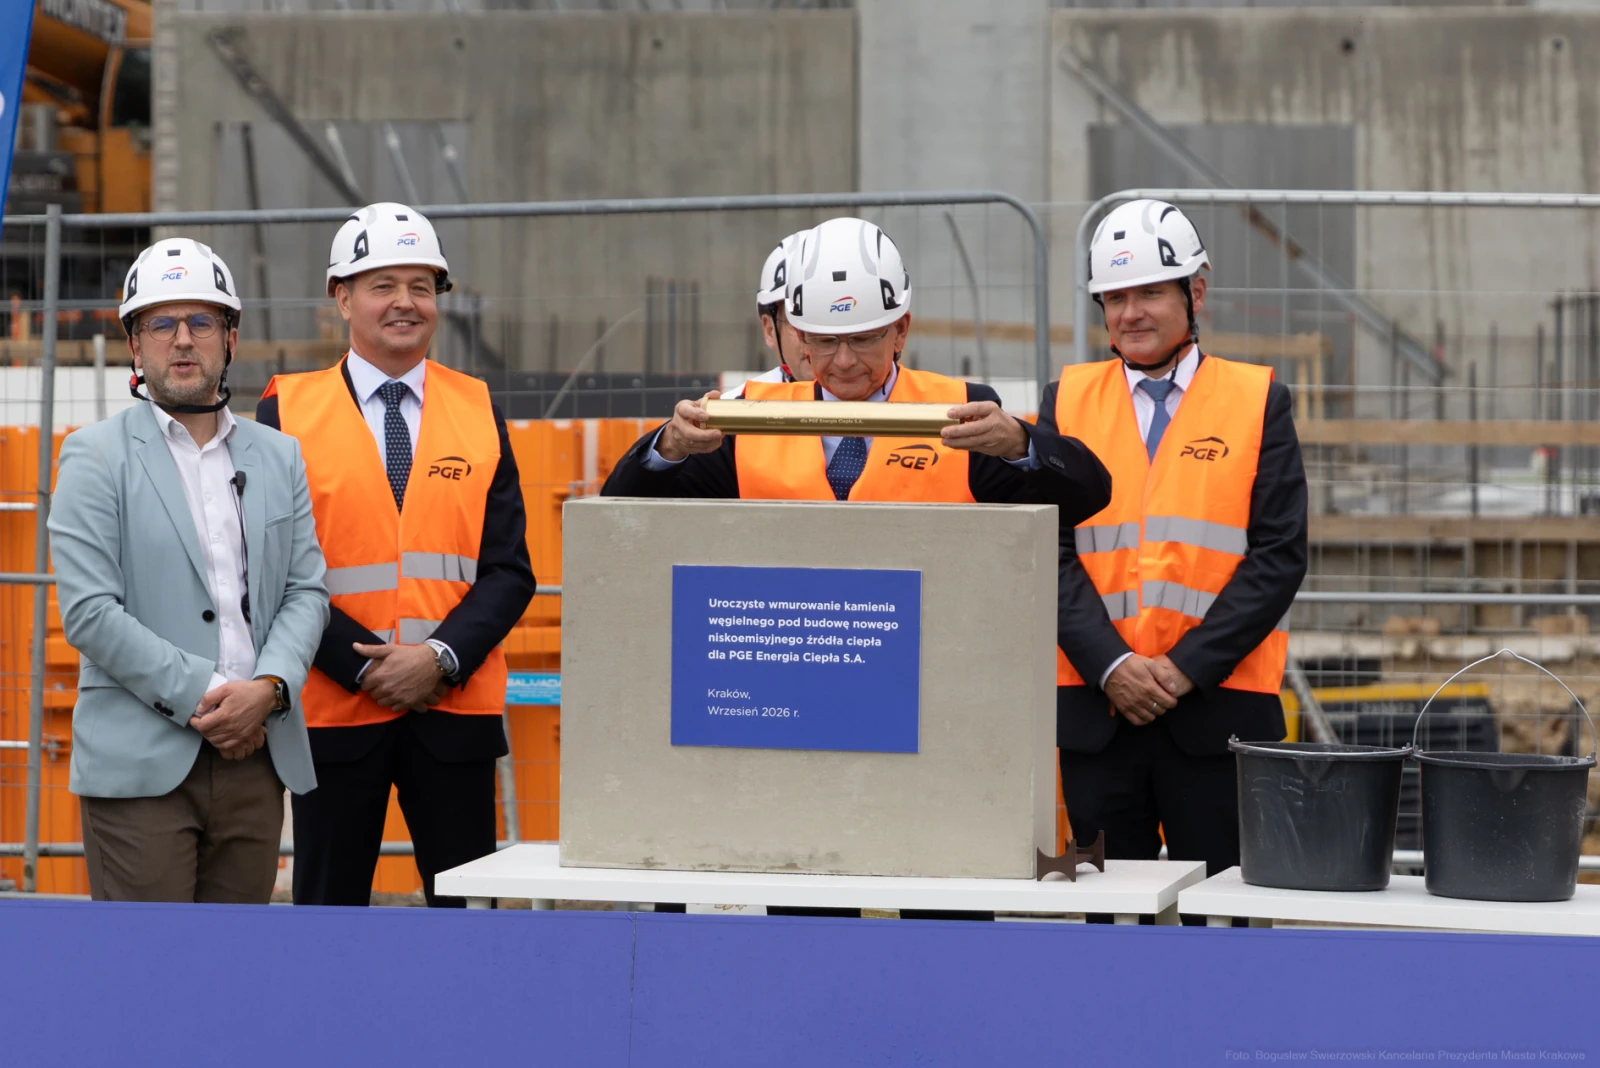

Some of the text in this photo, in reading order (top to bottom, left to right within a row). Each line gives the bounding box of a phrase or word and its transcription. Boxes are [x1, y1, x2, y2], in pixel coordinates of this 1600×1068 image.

[397, 238, 416, 246] PGE
[1110, 257, 1129, 268] PGE
[161, 272, 183, 281] PGE
[830, 303, 852, 313] PGE
[1180, 445, 1219, 461] PGE
[886, 453, 929, 471] PGE
[428, 465, 463, 481] PGE
[708, 597, 896, 613] Uroczyste wmurowanie kamienia
[708, 615, 899, 631] węgielnego pod budowę nowego
[708, 632, 882, 648] niskoemisyjnego źródła ciepła
[707, 649, 866, 665] dla PGE Energia Ciepła S.A.
[707, 688, 751, 700] Kraków,
[707, 705, 800, 718] Wrzesień 2026 r.
